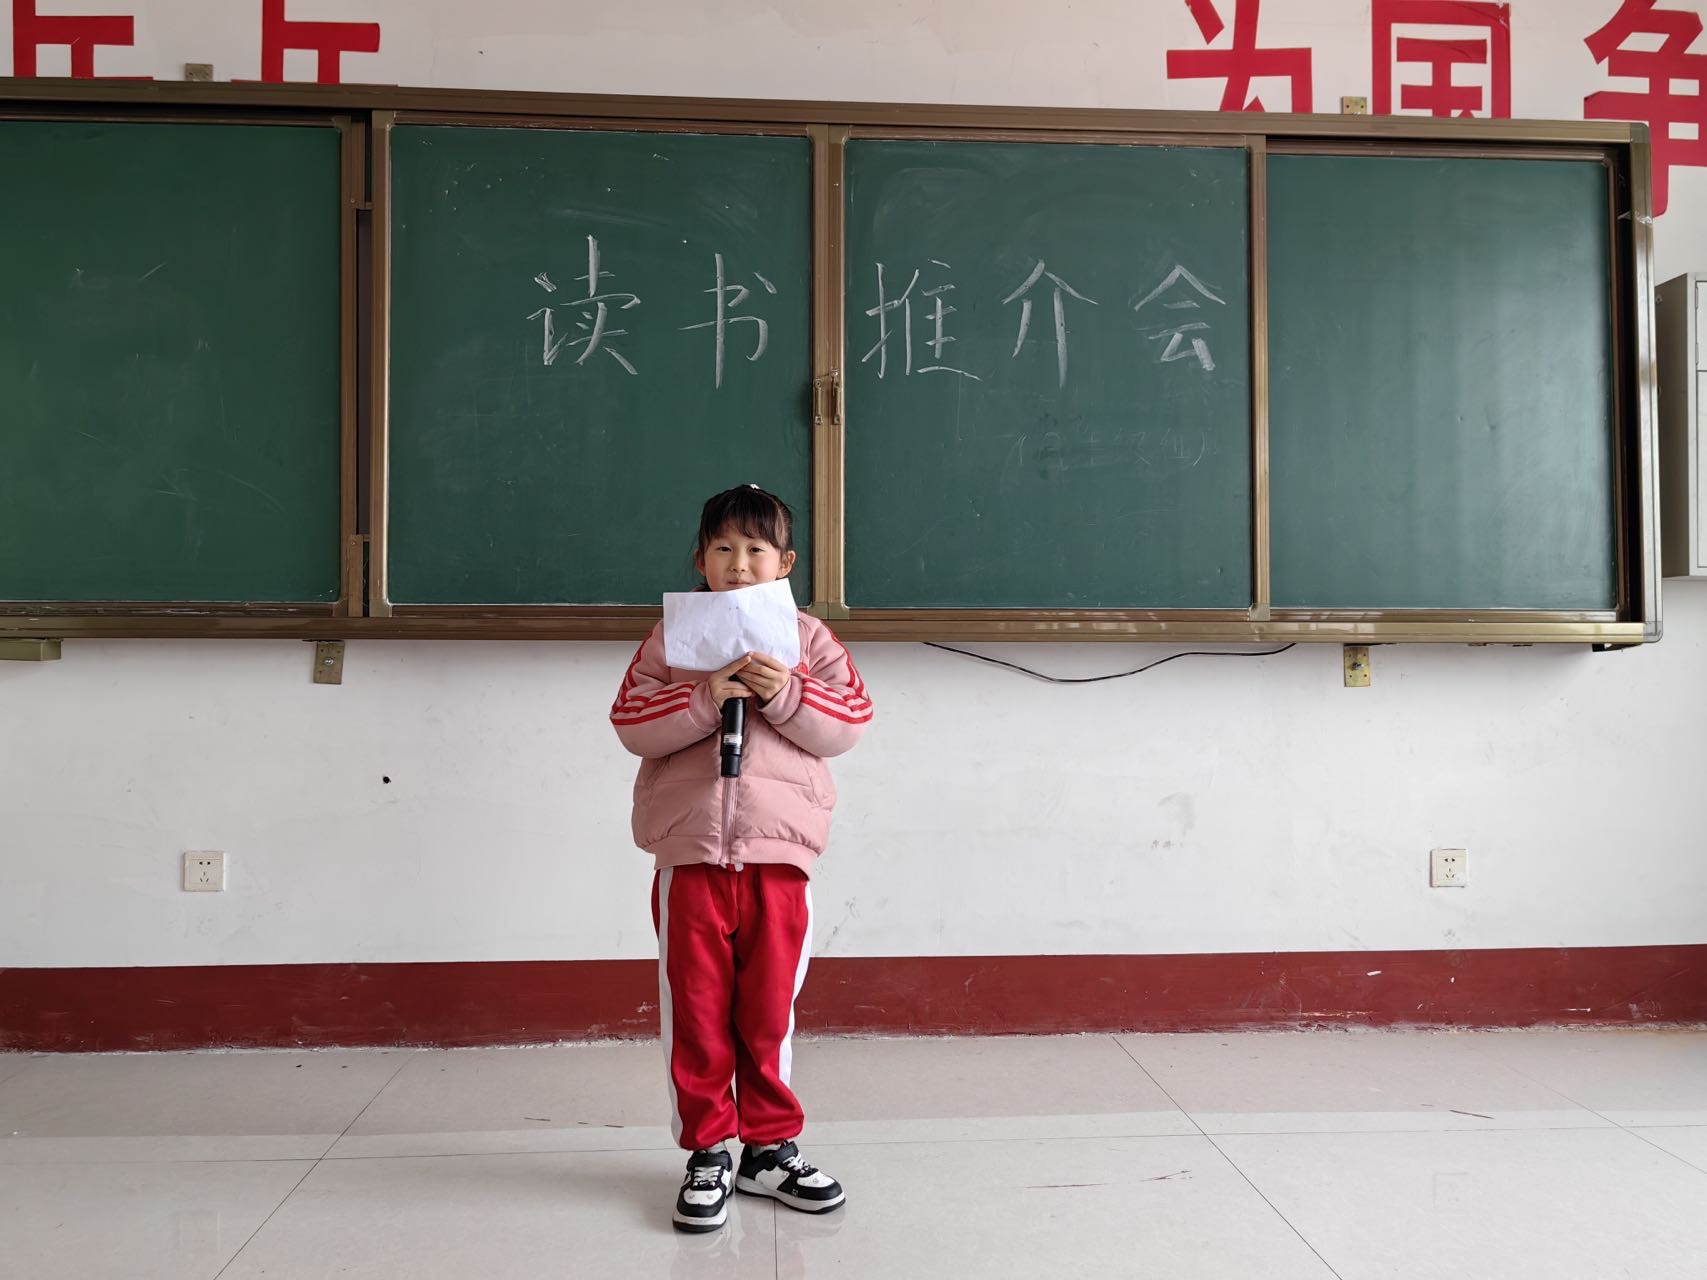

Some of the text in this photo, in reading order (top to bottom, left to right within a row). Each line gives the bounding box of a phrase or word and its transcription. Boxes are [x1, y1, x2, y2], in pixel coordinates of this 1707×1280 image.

[526, 234, 1226, 389] 读书推介会
